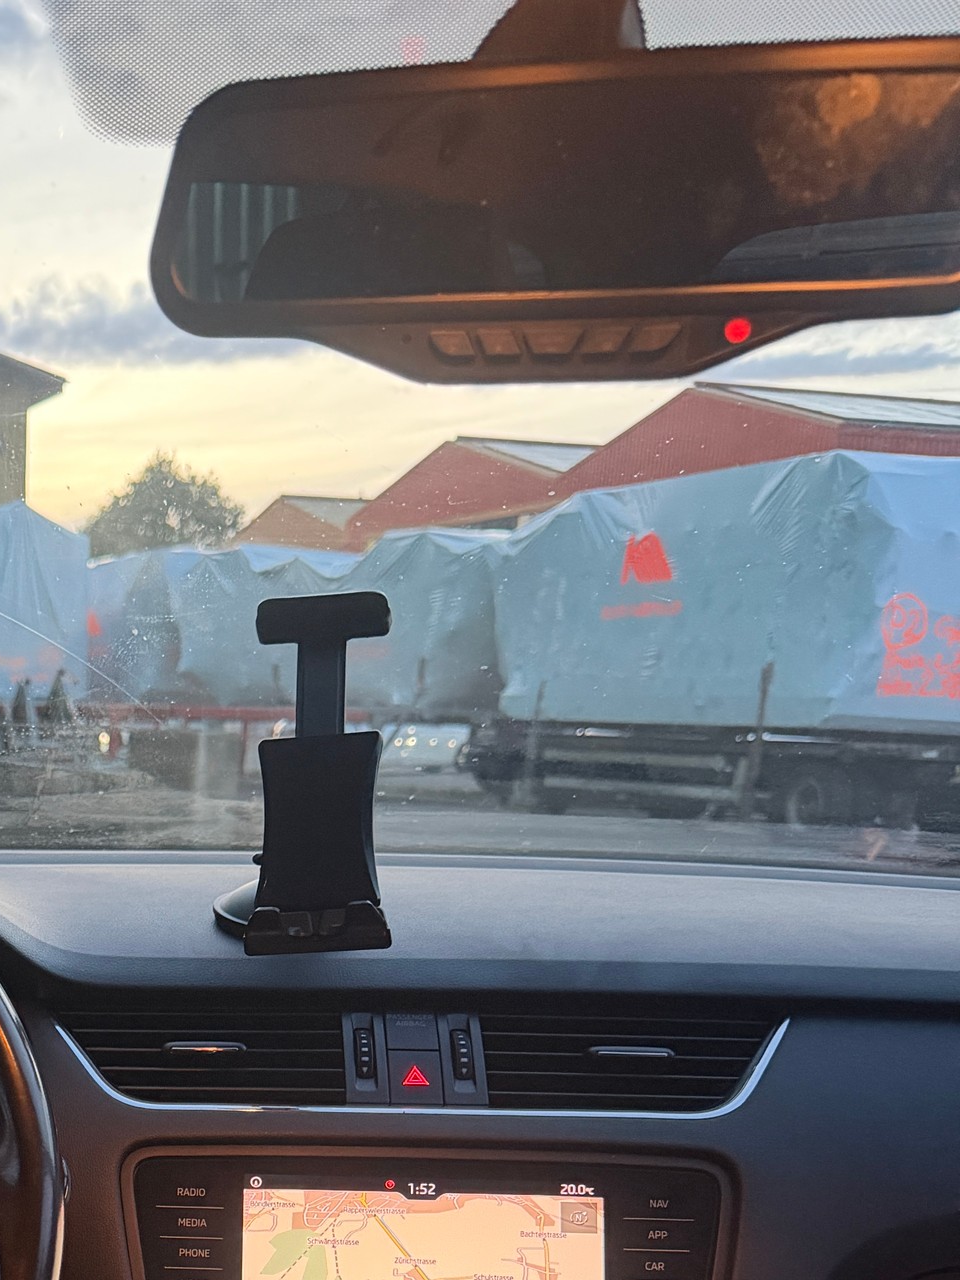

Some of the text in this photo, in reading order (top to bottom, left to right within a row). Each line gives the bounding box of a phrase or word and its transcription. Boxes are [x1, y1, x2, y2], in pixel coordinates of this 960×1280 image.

[177, 1187, 206, 1197] RADIO
[407, 1183, 436, 1196] 1:52
[649, 1200, 669, 1208] NAV
[178, 1218, 207, 1228] MEDIA
[648, 1231, 668, 1240] APP
[179, 1249, 210, 1258] PHONE
[645, 1262, 665, 1271] CAR
